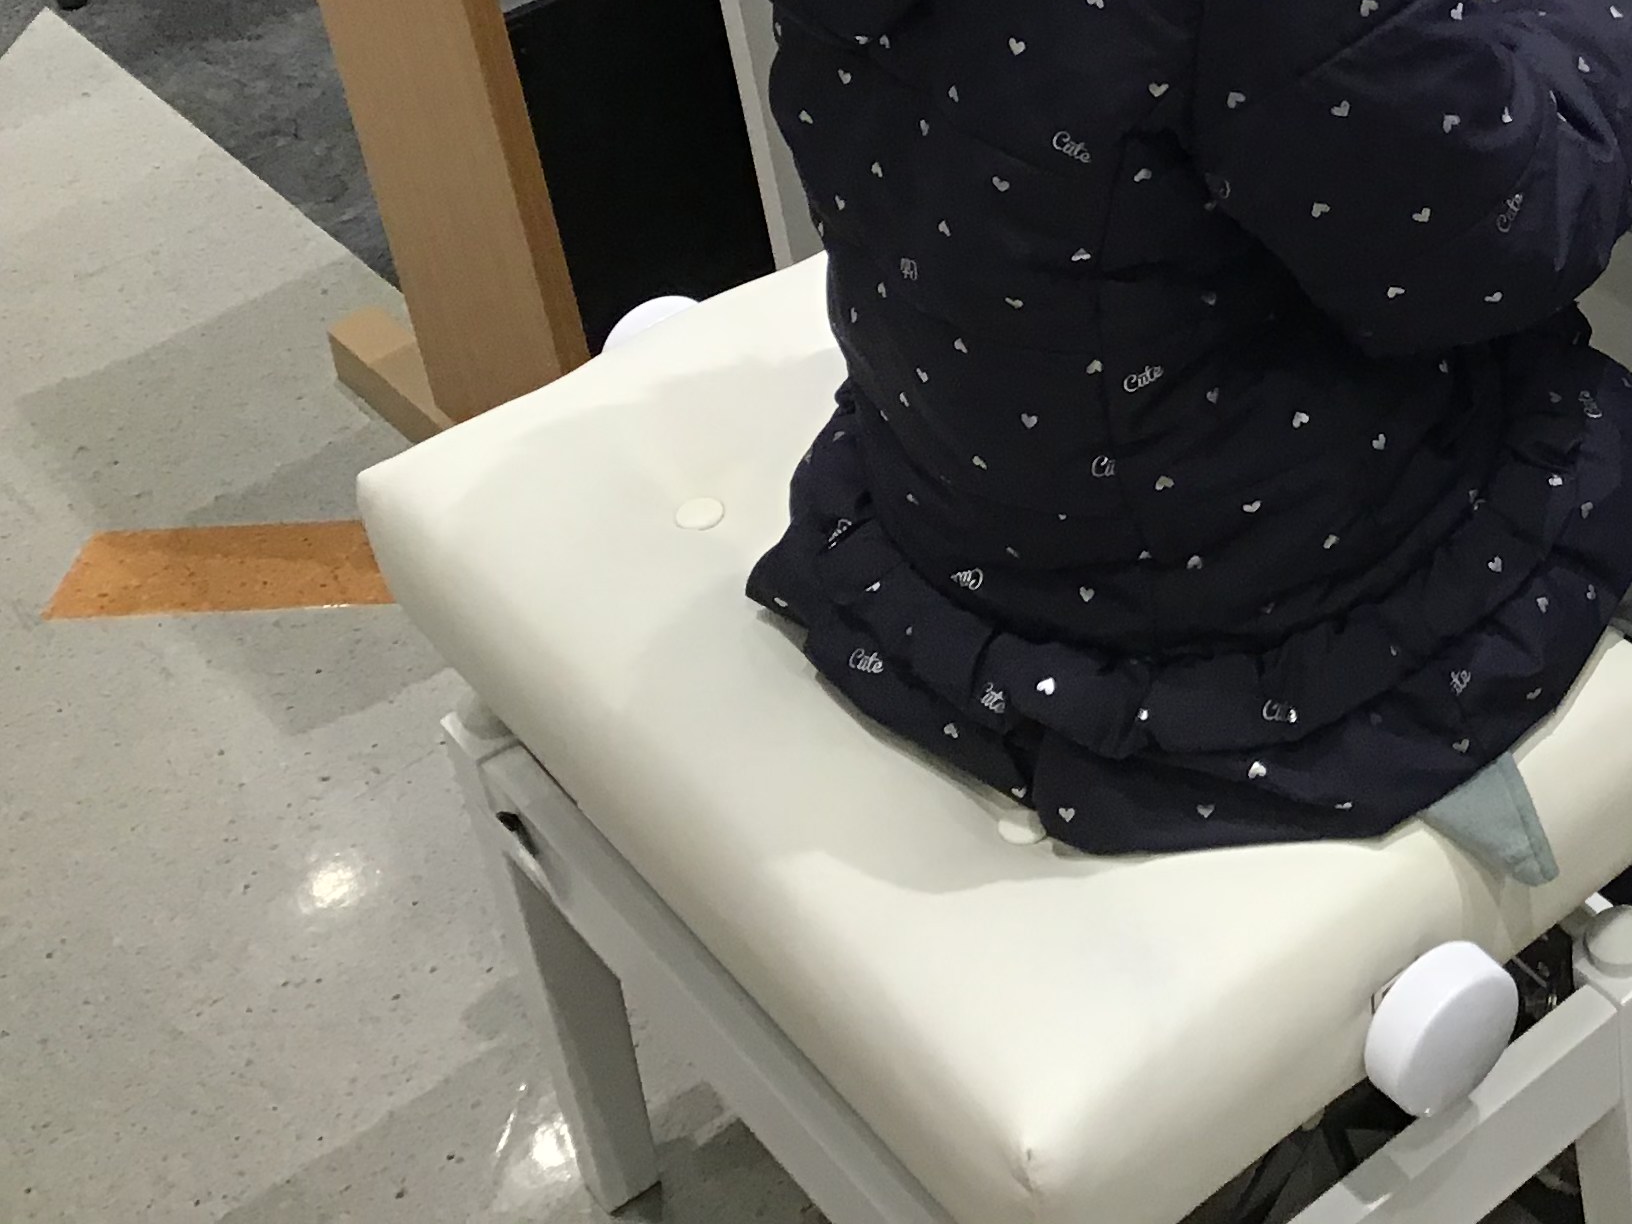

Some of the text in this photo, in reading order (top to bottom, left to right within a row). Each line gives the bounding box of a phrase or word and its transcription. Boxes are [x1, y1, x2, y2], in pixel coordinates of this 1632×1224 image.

[1052, 131, 1092, 163] Cute
[1496, 192, 1524, 233] Cute
[1123, 365, 1164, 393] Cute
[1091, 455, 1116, 478] Cu
[849, 648, 885, 674] Cute
